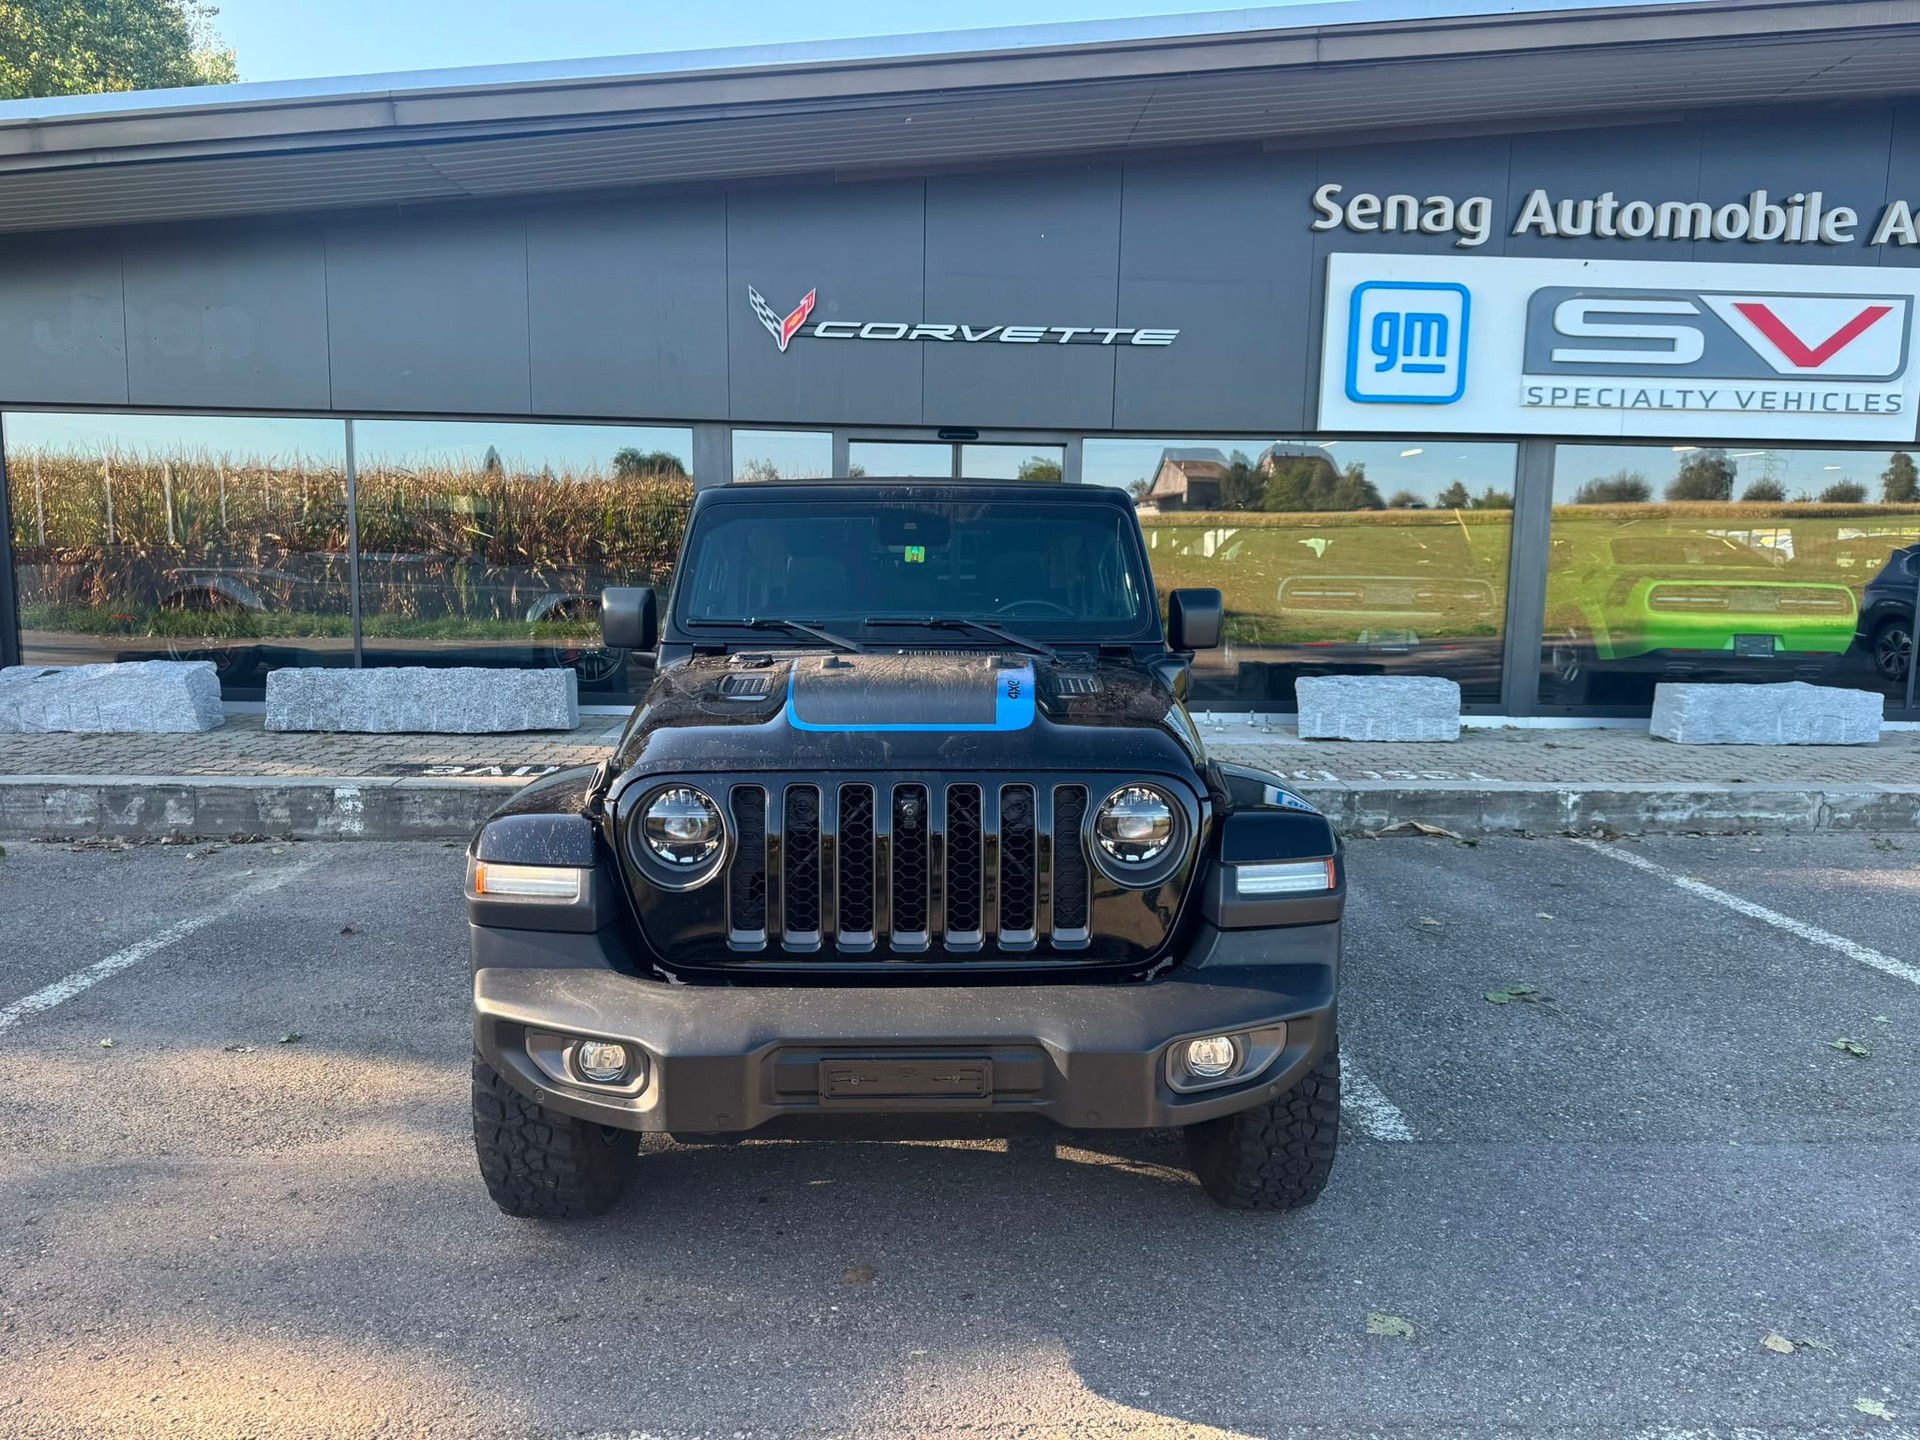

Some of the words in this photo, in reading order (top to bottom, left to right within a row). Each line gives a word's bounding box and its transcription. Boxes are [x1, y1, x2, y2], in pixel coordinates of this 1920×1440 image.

[1312, 184, 1492, 246] Senag
[1514, 190, 1858, 243] Automobile
[1870, 200, 1920, 246] A
[813, 320, 1181, 347] CORVETTE
[1371, 311, 1449, 373] gm
[1551, 298, 1895, 369] SV
[1527, 387, 1718, 408] SPECIALTY
[1735, 391, 1902, 412] VEHICLES
